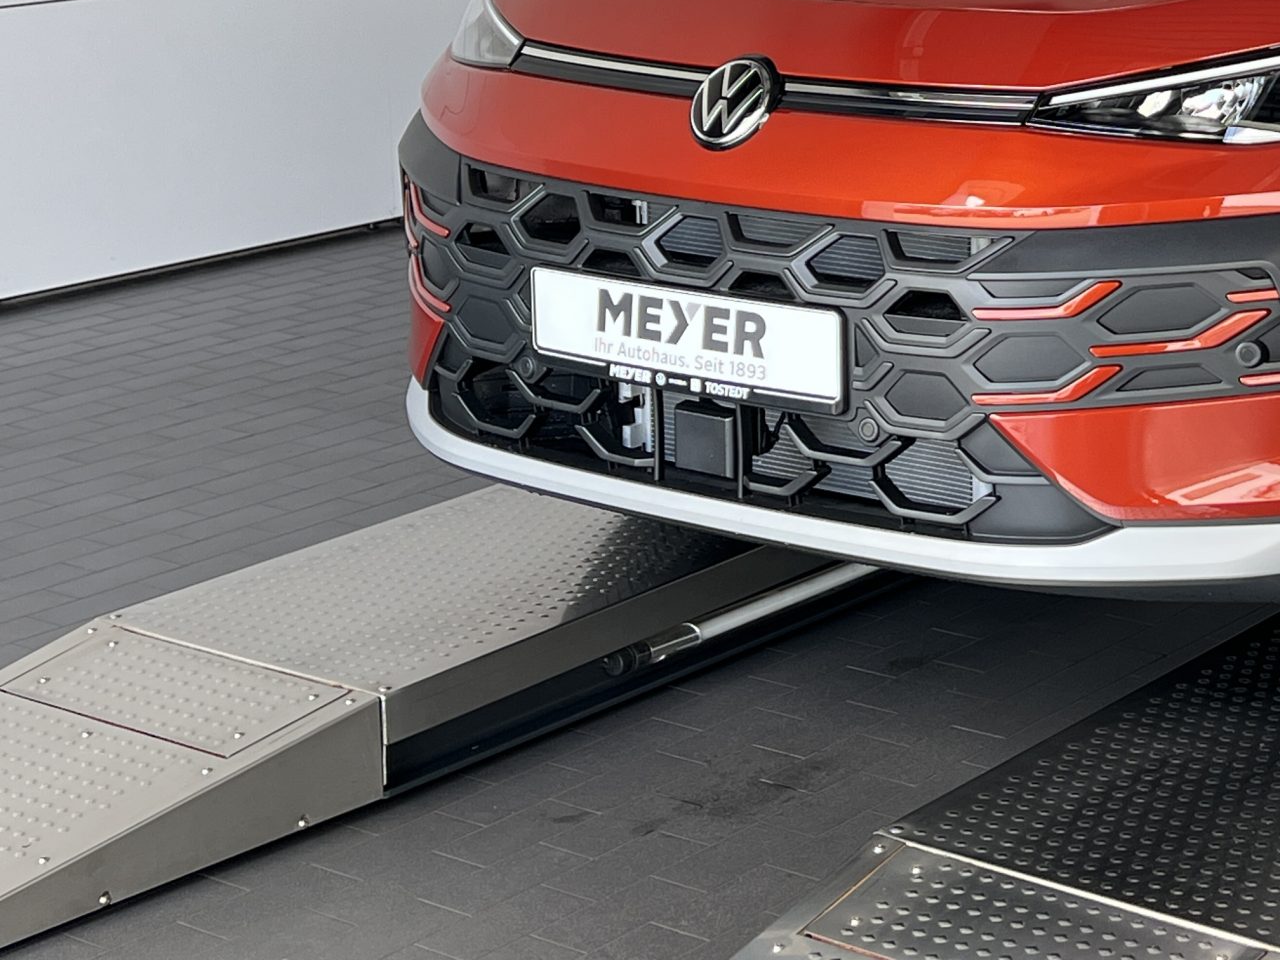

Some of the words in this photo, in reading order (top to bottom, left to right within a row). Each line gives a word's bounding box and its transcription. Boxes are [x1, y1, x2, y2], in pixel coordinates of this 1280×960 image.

[596, 288, 766, 359] MEYER
[594, 337, 614, 353] Ihr
[617, 343, 690, 369] Autohaus.
[694, 356, 724, 375] Seit
[730, 360, 766, 381] 1893
[609, 363, 652, 384] MEYER
[704, 381, 751, 400] TOSTEDT
